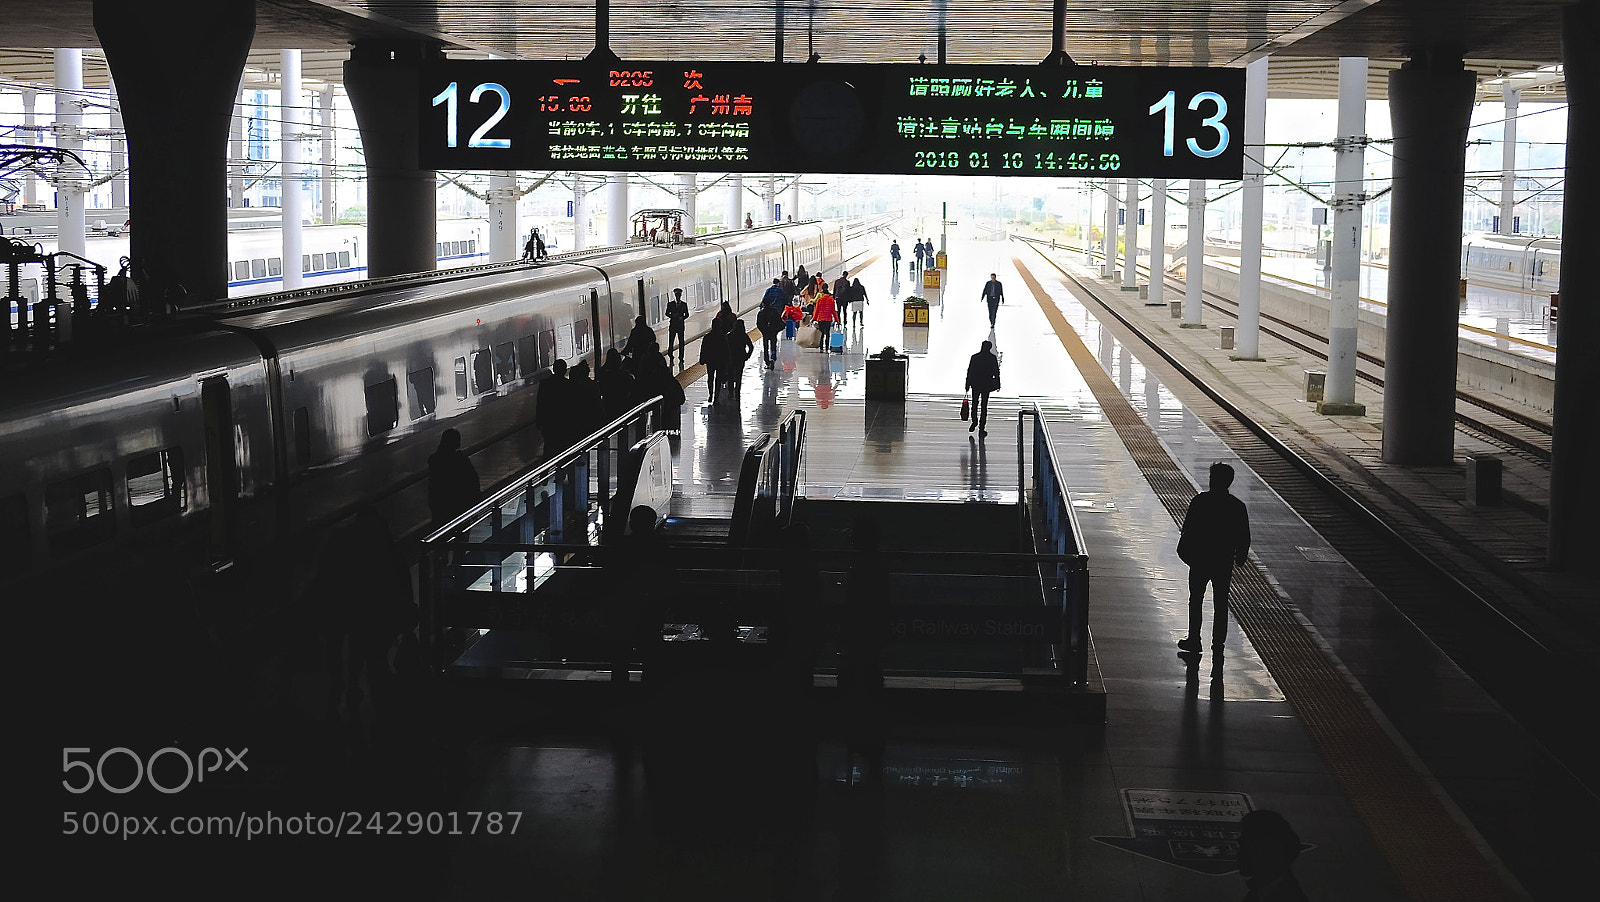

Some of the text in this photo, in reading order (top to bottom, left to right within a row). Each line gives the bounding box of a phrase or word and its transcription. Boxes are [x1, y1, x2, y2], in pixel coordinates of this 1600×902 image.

[684, 70, 704, 90] 次
[431, 82, 512, 149] 12
[621, 94, 662, 116] 开往
[688, 94, 754, 116] 广州南
[1148, 91, 1231, 159] 13
[914, 152, 1121, 172] 2018 01 16 14:45:50
[912, 619, 979, 637] Railway
[984, 619, 1045, 636] Station
